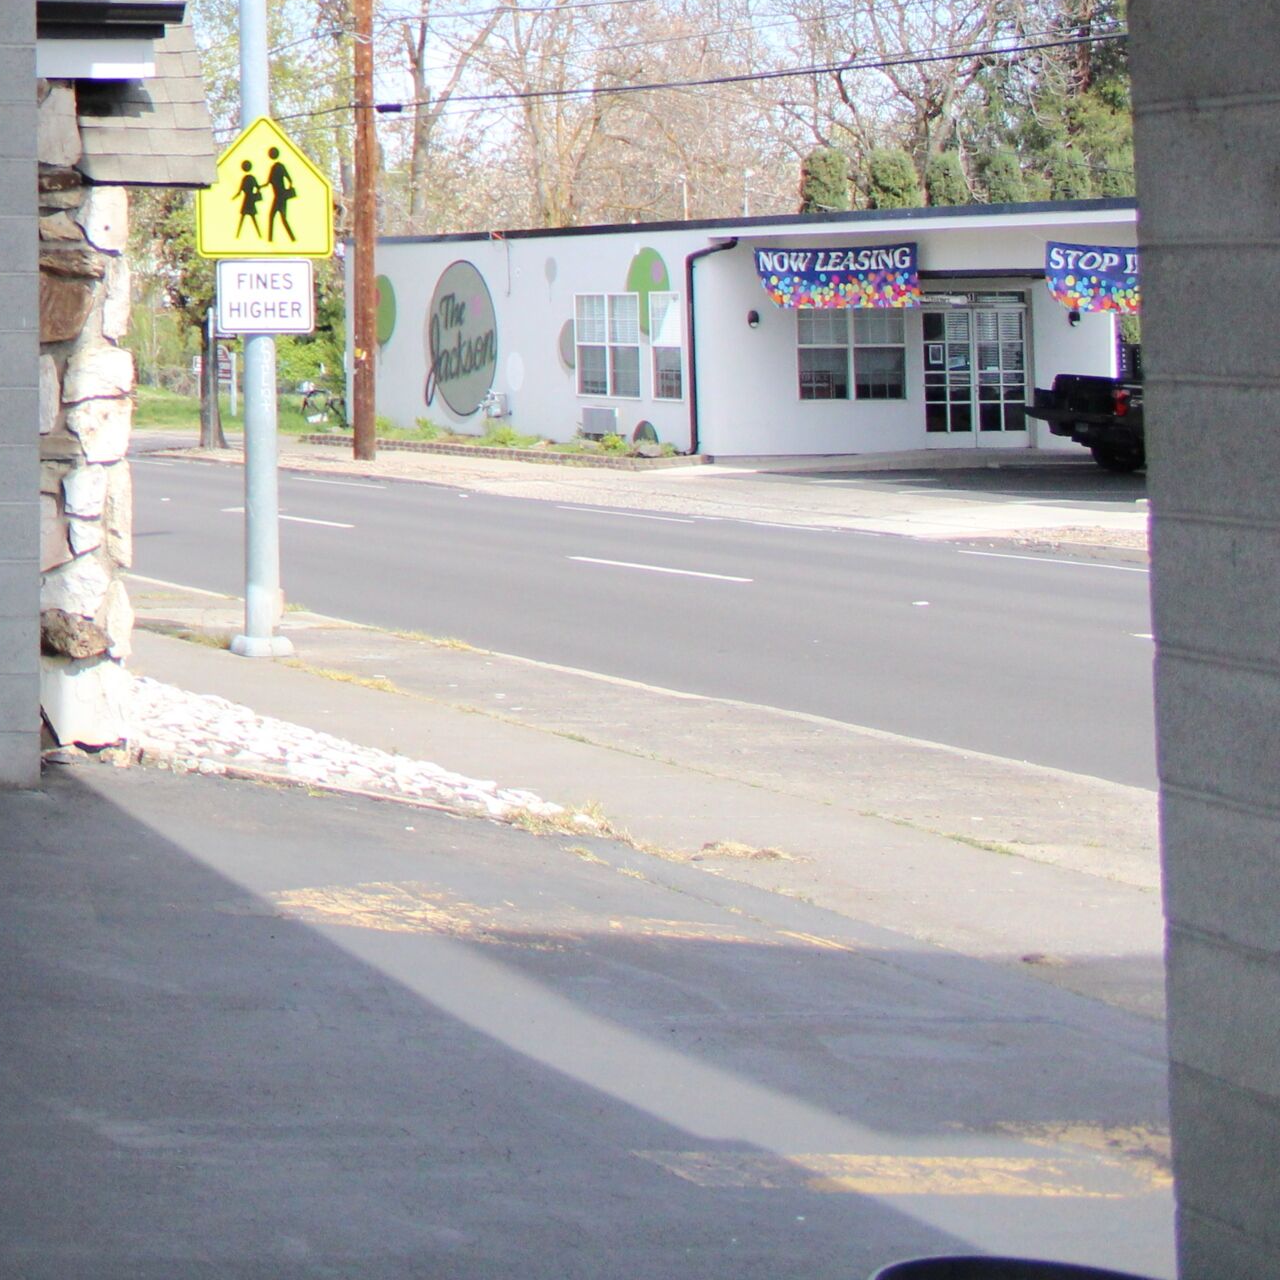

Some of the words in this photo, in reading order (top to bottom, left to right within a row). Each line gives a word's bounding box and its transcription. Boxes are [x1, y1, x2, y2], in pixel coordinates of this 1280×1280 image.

[758, 250, 812, 273] NOW
[814, 247, 912, 271] LEASING
[1049, 247, 1119, 272] STOP
[1123, 253, 1138, 274] I
[237, 272, 293, 290] FINES
[229, 301, 302, 319] HIGHER
[439, 292, 466, 330] The
[424, 312, 496, 407] Jackson
